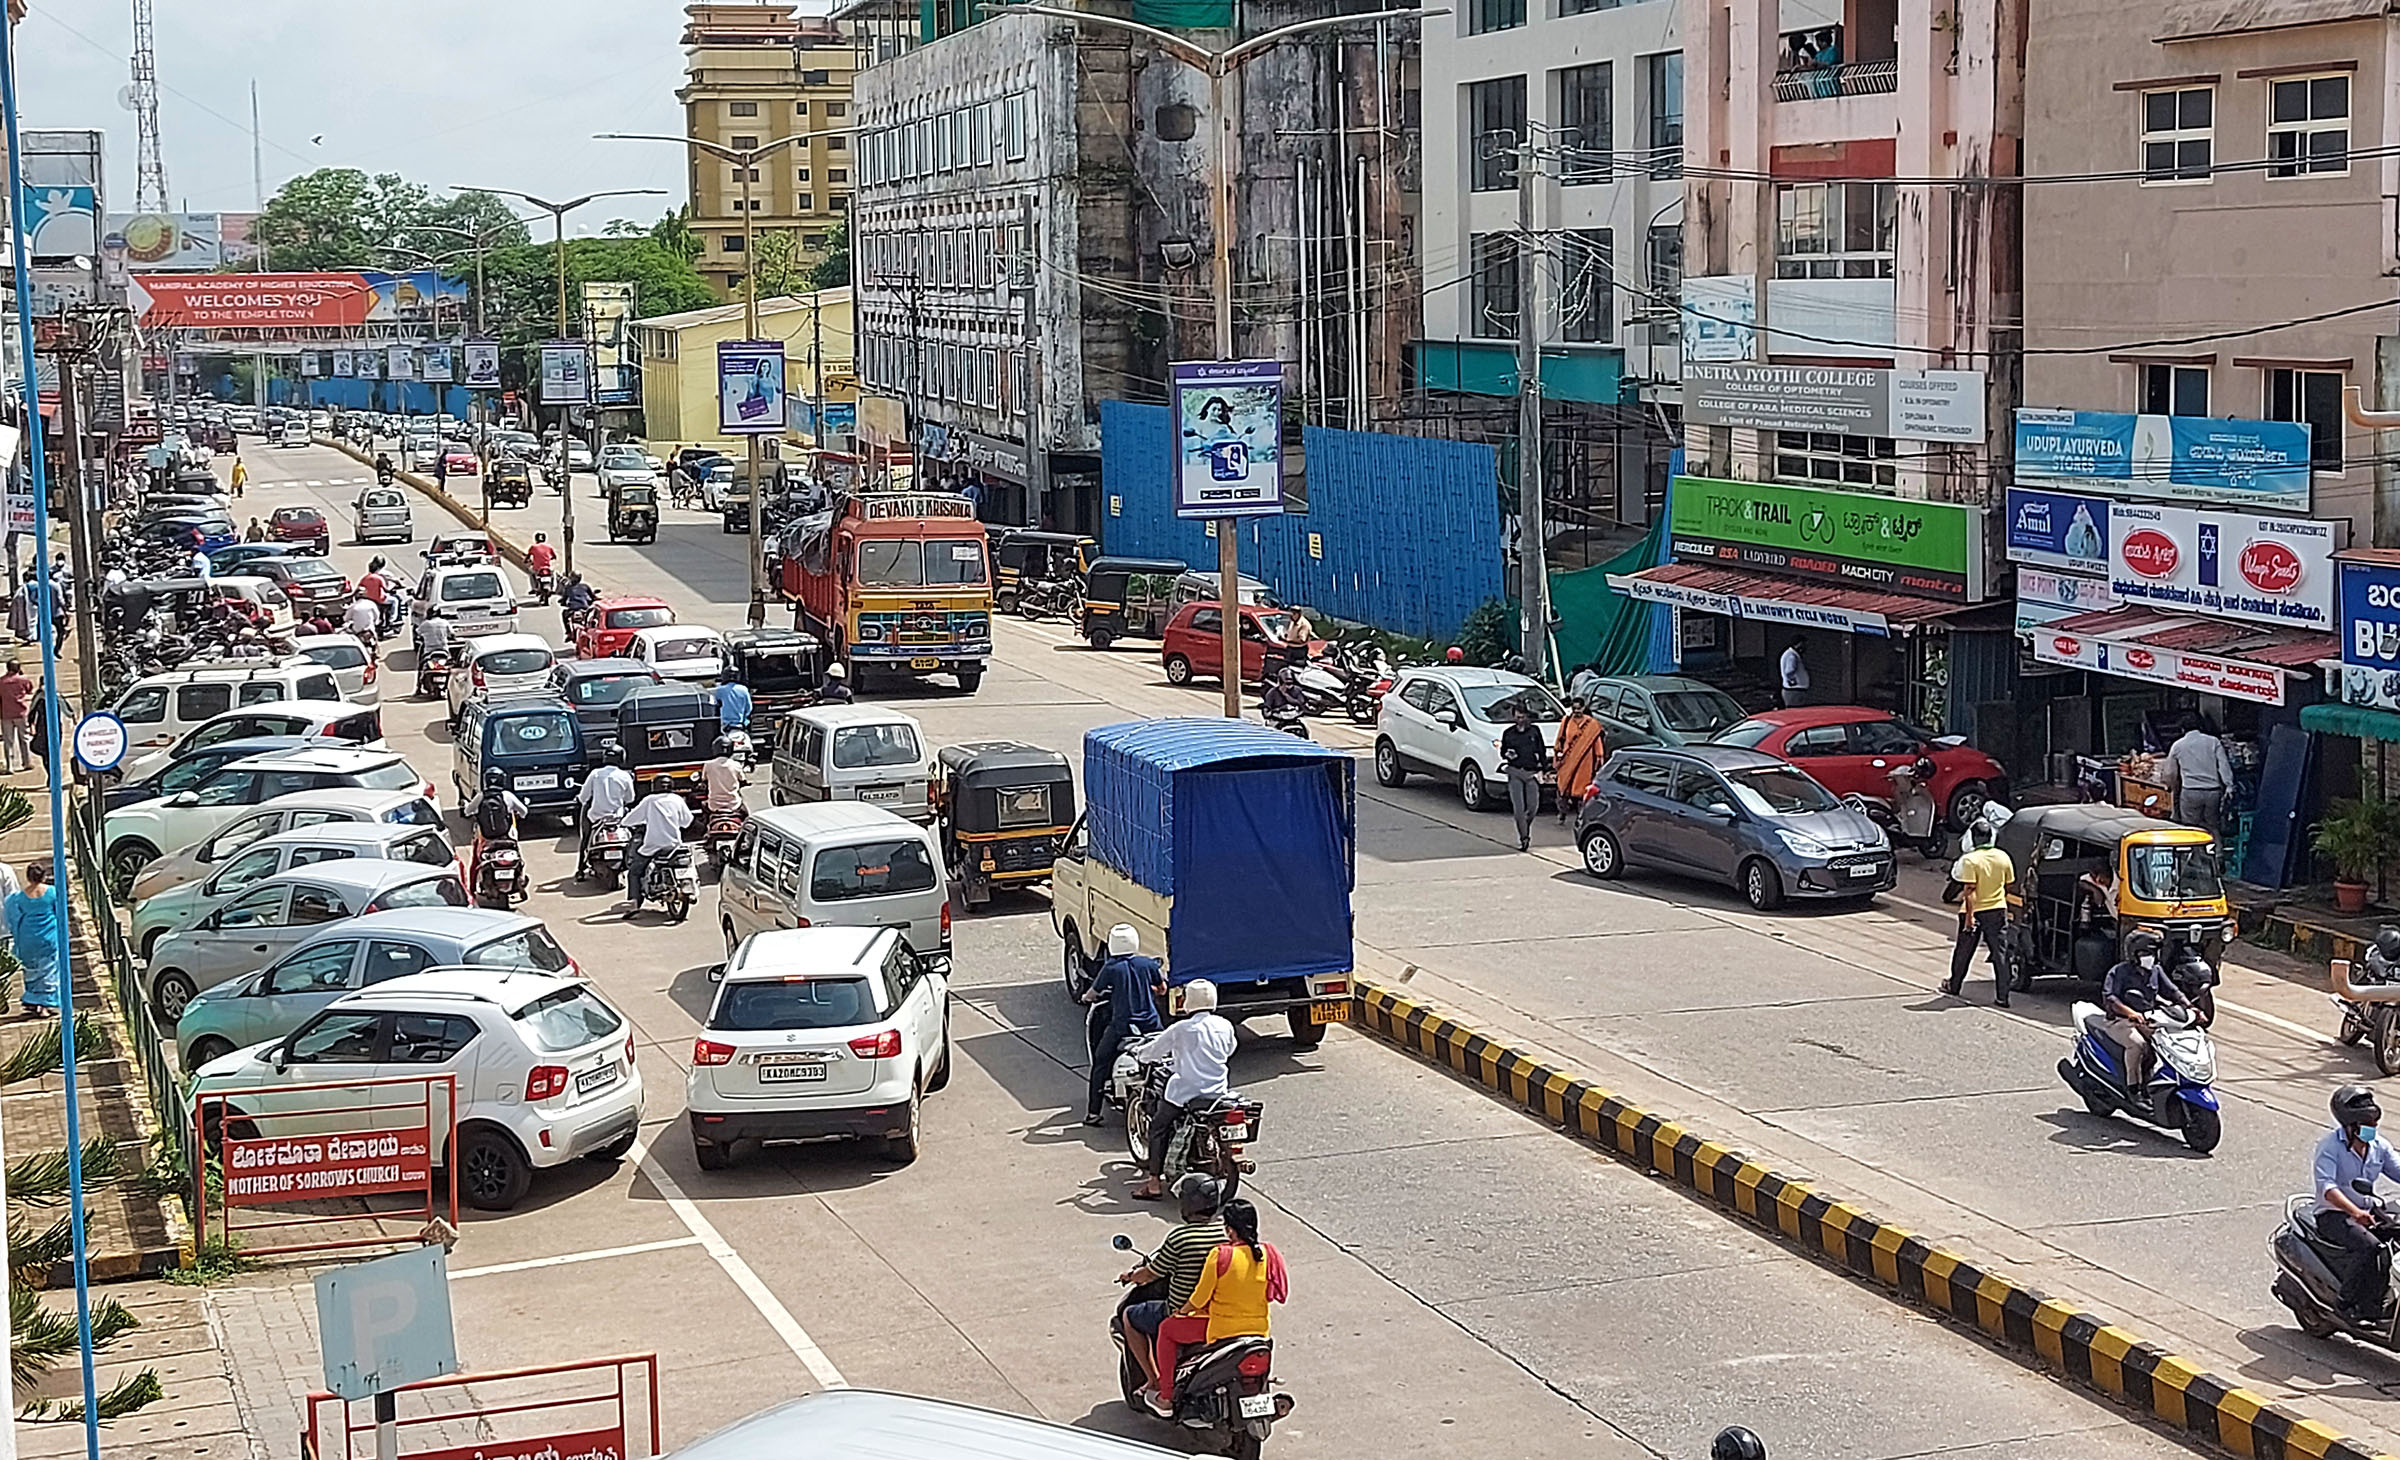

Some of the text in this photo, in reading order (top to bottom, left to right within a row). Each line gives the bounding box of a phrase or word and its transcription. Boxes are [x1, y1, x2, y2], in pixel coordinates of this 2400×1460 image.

[196, 281, 243, 289] ACADEMY
[245, 281, 258, 289] OF
[184, 294, 322, 307] WELCOMES YOU
[193, 310, 314, 320] TO THE TEMPLE TOWN
[1695, 366, 1876, 387] NETRA JYOTHI COLLEGE
[1726, 382, 1765, 392] COLLEGE
[1768, 384, 1780, 393] OF
[1783, 385, 1842, 396] OPTOMETRY
[1698, 400, 1734, 410] COLLEGE
[1738, 402, 1750, 410] OF
[1752, 402, 1778, 412] PARA
[1781, 404, 1826, 416] MEDICAL
[1827, 407, 1872, 418] SCIENCES
[2026, 435, 2124, 457] UDUPI AYURVEDA
[2052, 455, 2096, 473] STORES
[869, 499, 915, 518] DEVAKI
[2016, 508, 2051, 533] Amul
[1674, 541, 1715, 556] HERCULES
[1744, 549, 1786, 566] LADYBIRD
[1901, 576, 1963, 593] montra
[1795, 610, 1818, 622] CYCLE
[1820, 612, 1849, 626] WORKS
[228, 1175, 279, 1196] MOTHER
[280, 1174, 295, 1191] OF
[296, 1168, 355, 1190] SORROWS
[356, 1164, 399, 1185] CHURCH
[352, 1281, 416, 1376] P
